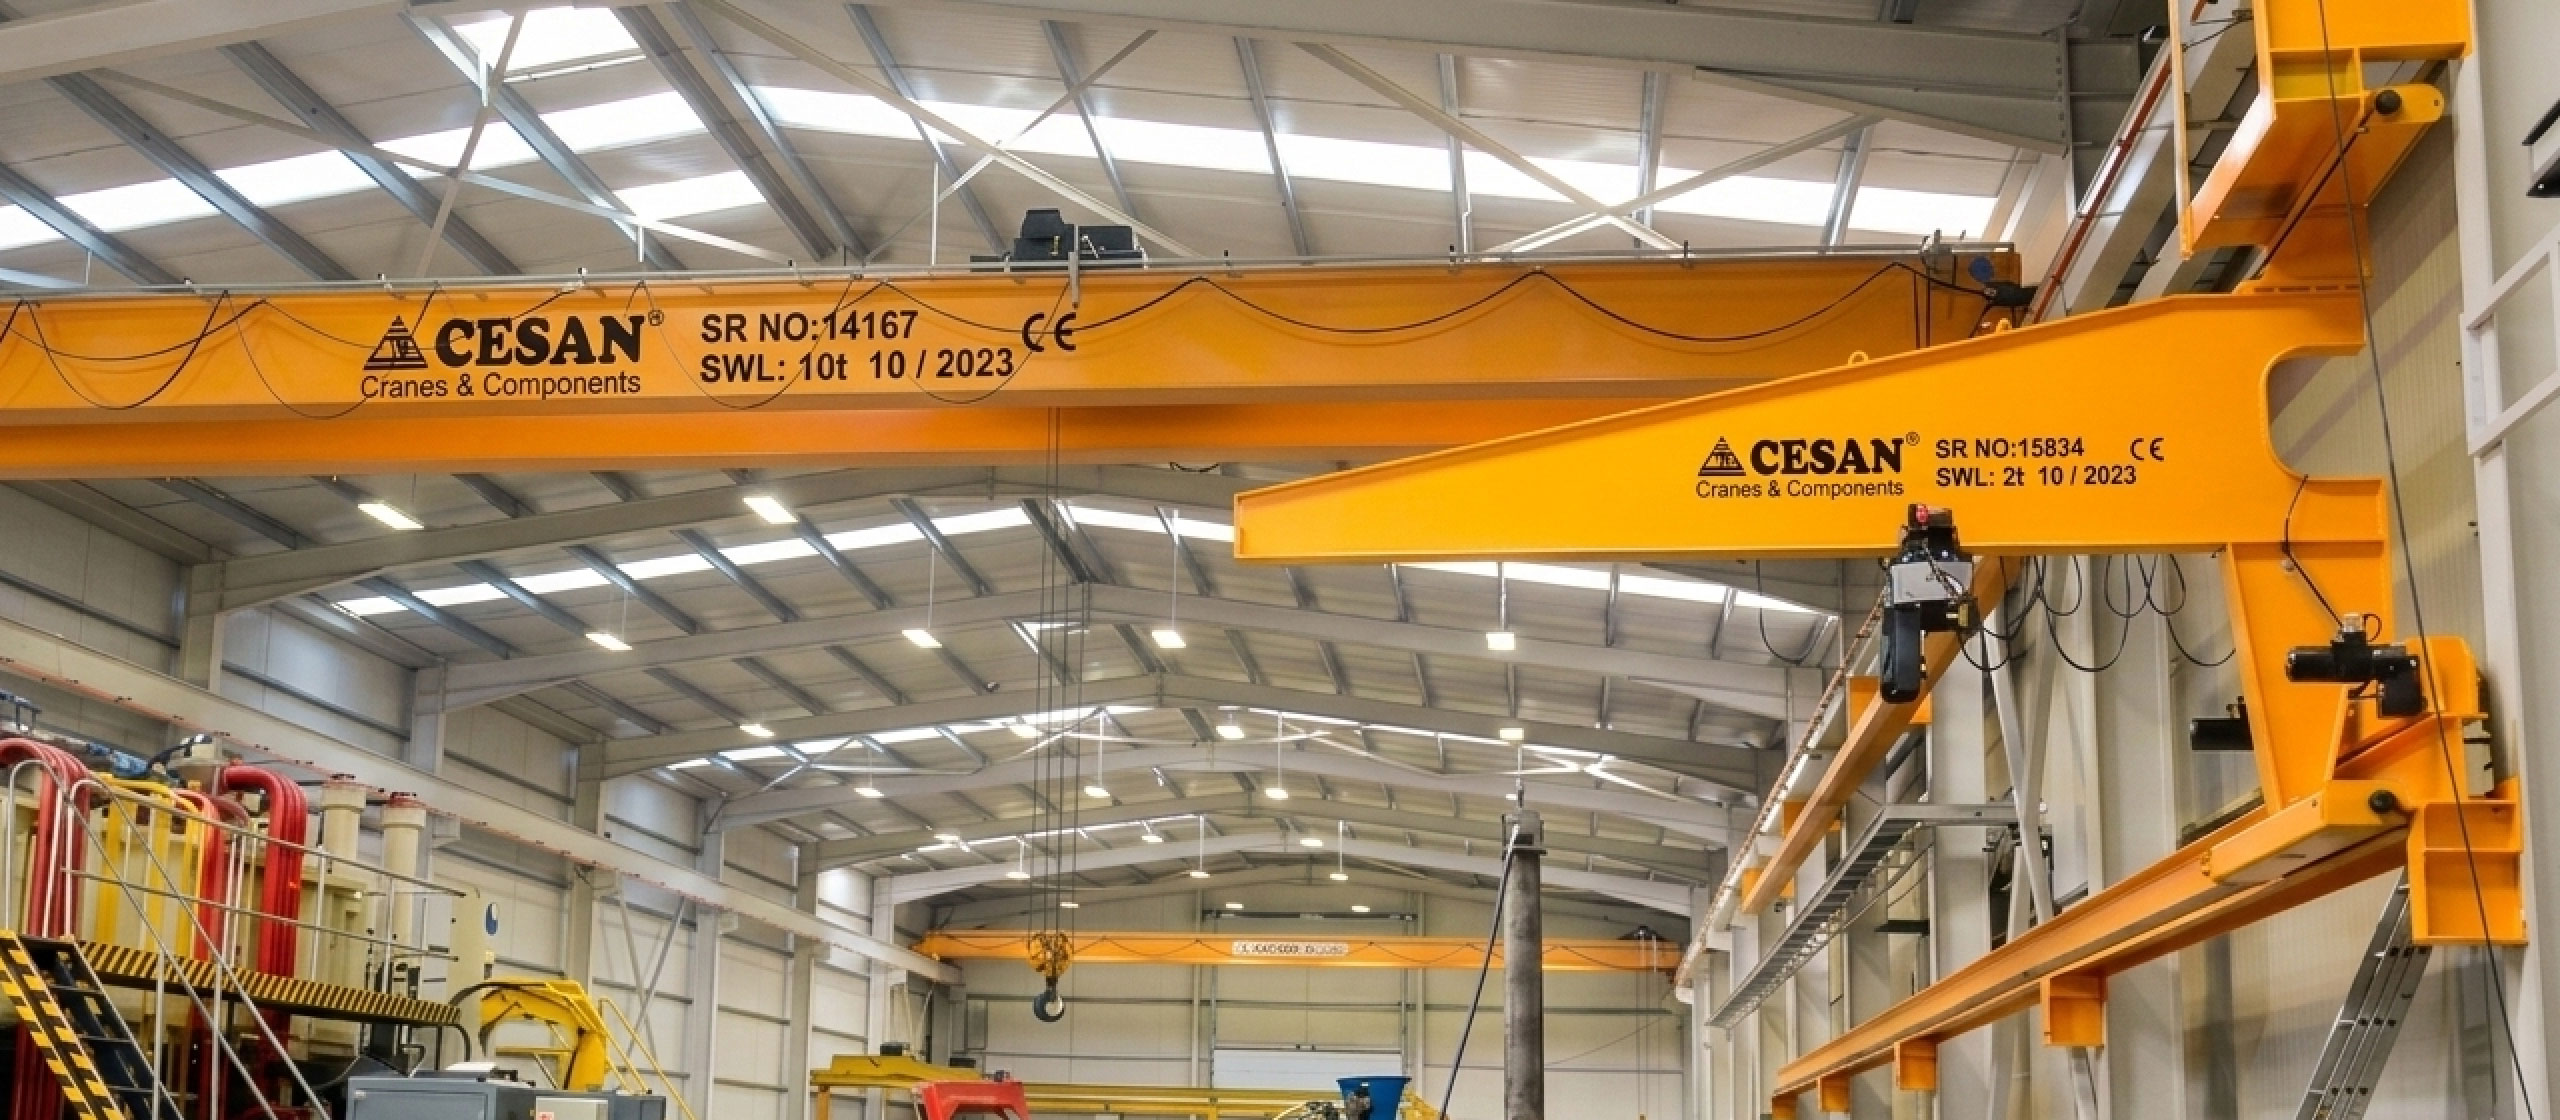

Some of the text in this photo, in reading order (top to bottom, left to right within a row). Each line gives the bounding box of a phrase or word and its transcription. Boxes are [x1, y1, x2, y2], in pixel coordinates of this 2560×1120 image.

[701, 310, 919, 342] SR NO:14167
[701, 347, 1014, 382] SWL: 10t 10 / 2023
[361, 371, 641, 400] Cranes & Components
[1935, 436, 2085, 458] SR NO:15834
[2130, 437, 2165, 462] CE
[1935, 464, 2137, 487] SWL: 2t 10 / 2023
[1696, 479, 1905, 500] Cranes & Components
